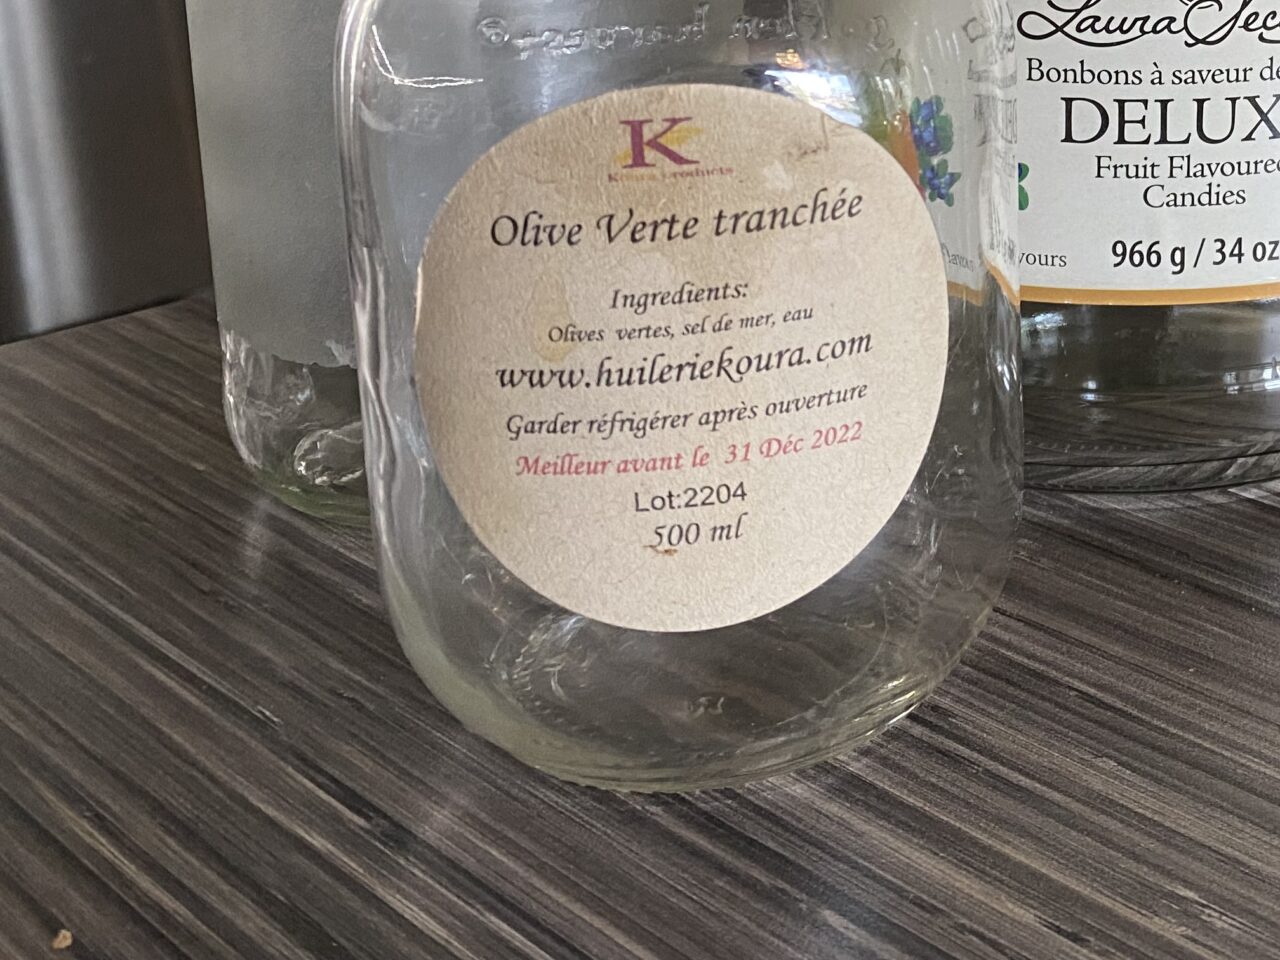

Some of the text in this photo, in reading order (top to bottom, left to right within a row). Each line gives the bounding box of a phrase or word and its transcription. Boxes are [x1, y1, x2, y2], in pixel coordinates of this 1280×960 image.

[1026, 57, 1143, 86] Bonbons
[1151, 61, 1165, 85] à
[1171, 60, 1252, 85] saveur
[619, 116, 701, 169] K
[1094, 154, 1161, 181] Fruit
[1142, 183, 1248, 210] Candies
[491, 187, 864, 247] Olive Verte tranchée
[1111, 237, 1280, 275] 966 g / 34 oz
[609, 281, 750, 315] Ingredients:
[548, 305, 815, 343] Olives vertes, sel de mer, eau
[496, 332, 874, 389] www.huileriekoura.com
[506, 383, 870, 441] Garder réfrigérer après ouverture
[515, 420, 864, 477] Meilleur avant le 31 Déc 2022
[634, 480, 749, 513] Lot:2204
[653, 511, 750, 548] 500 ml
